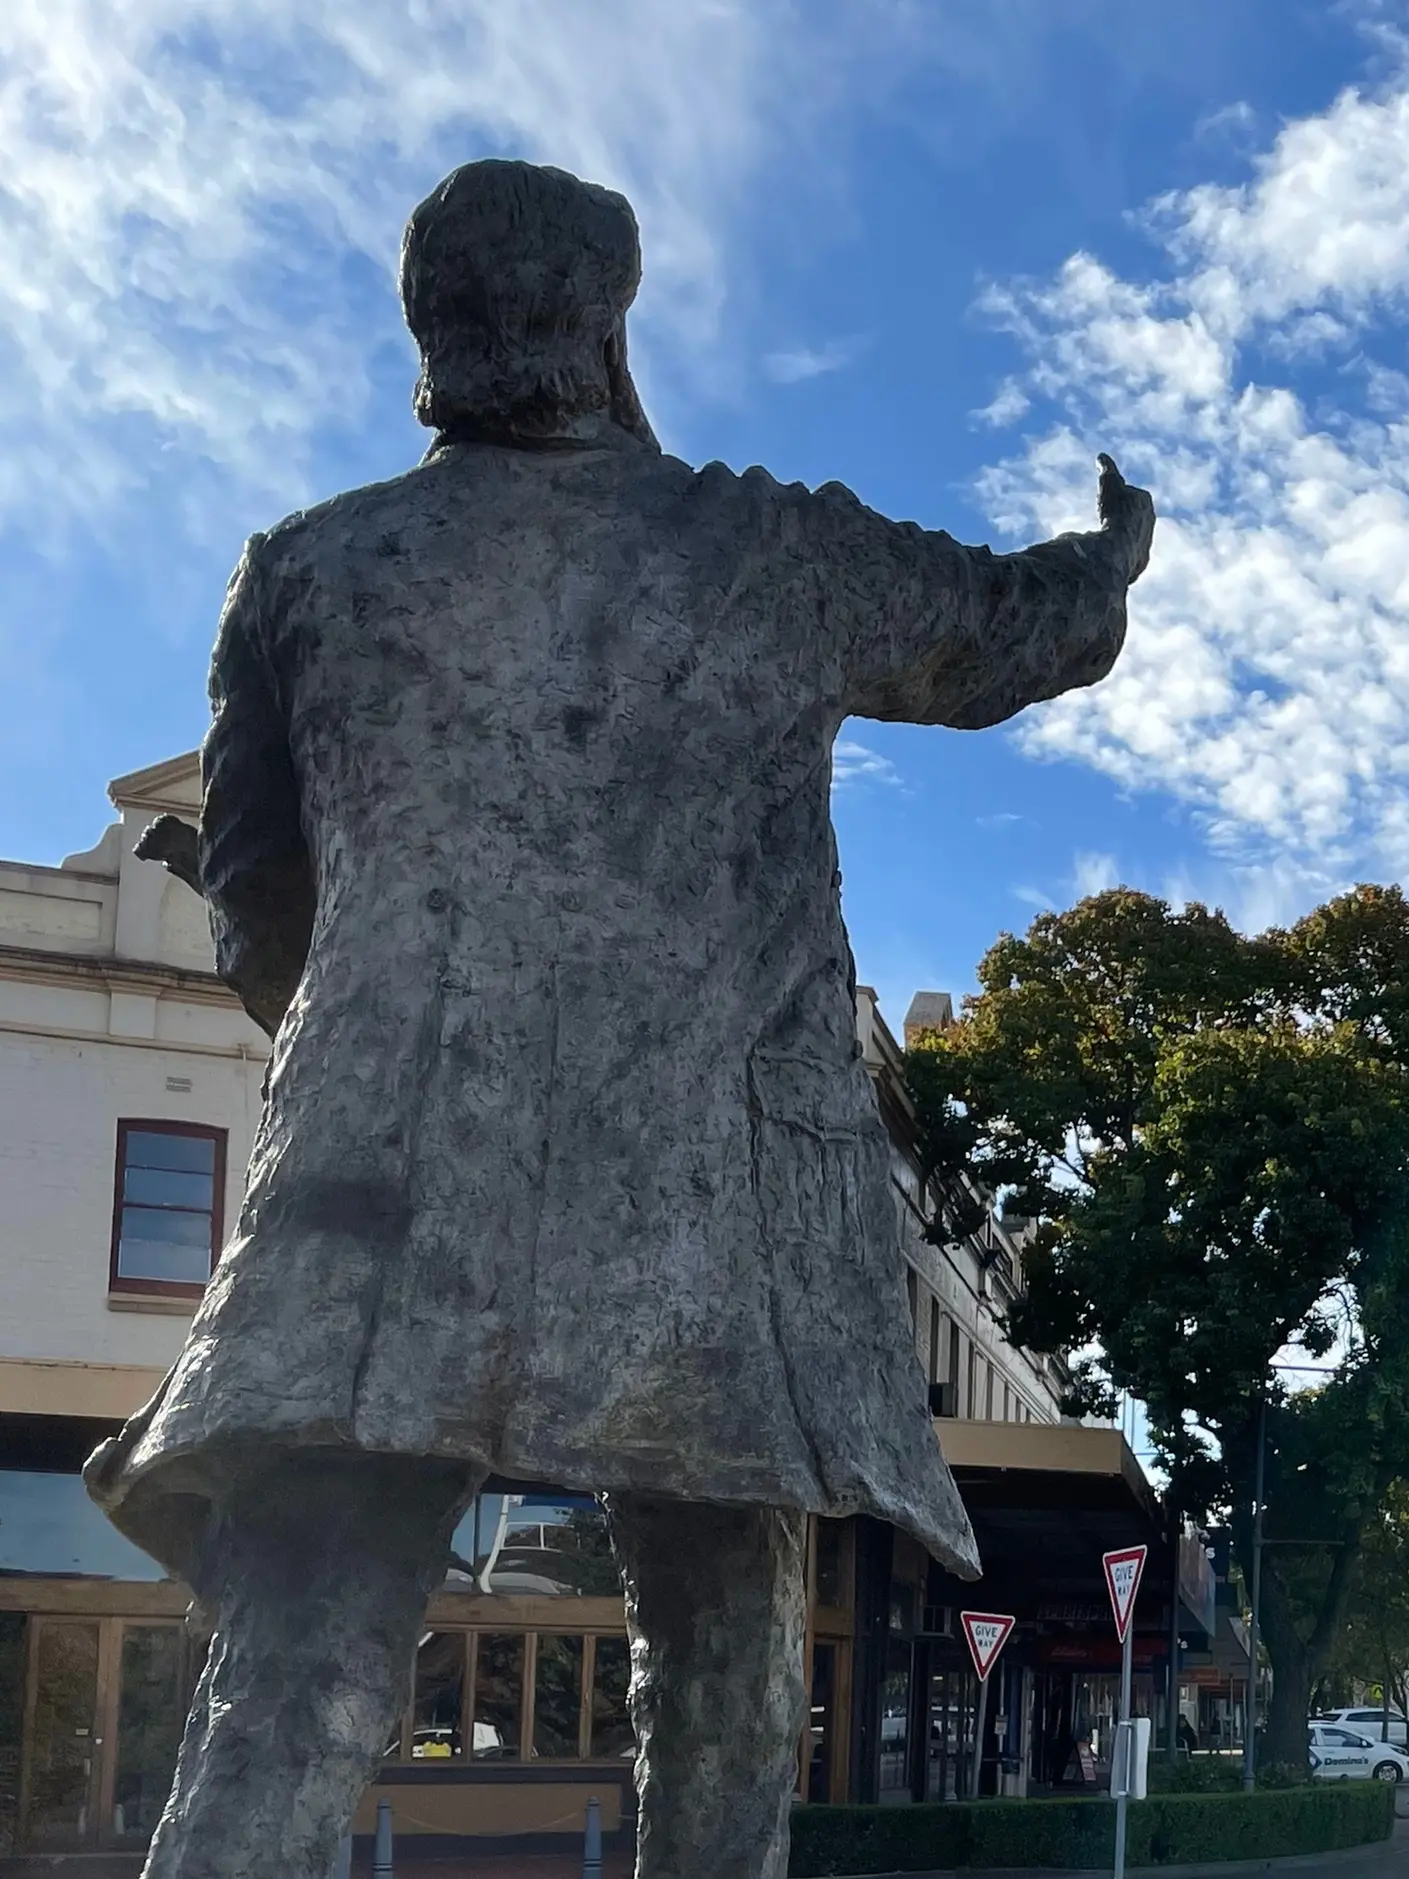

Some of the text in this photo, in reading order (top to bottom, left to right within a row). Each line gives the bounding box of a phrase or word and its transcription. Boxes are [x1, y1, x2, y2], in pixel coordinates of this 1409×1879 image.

[1115, 1565, 1133, 1582] GIVE
[1118, 1585, 1130, 1596] WAY
[975, 1625, 998, 1638] GIVE
[978, 1639, 993, 1649] WAY
[1324, 1756, 1369, 1766] Domino's
